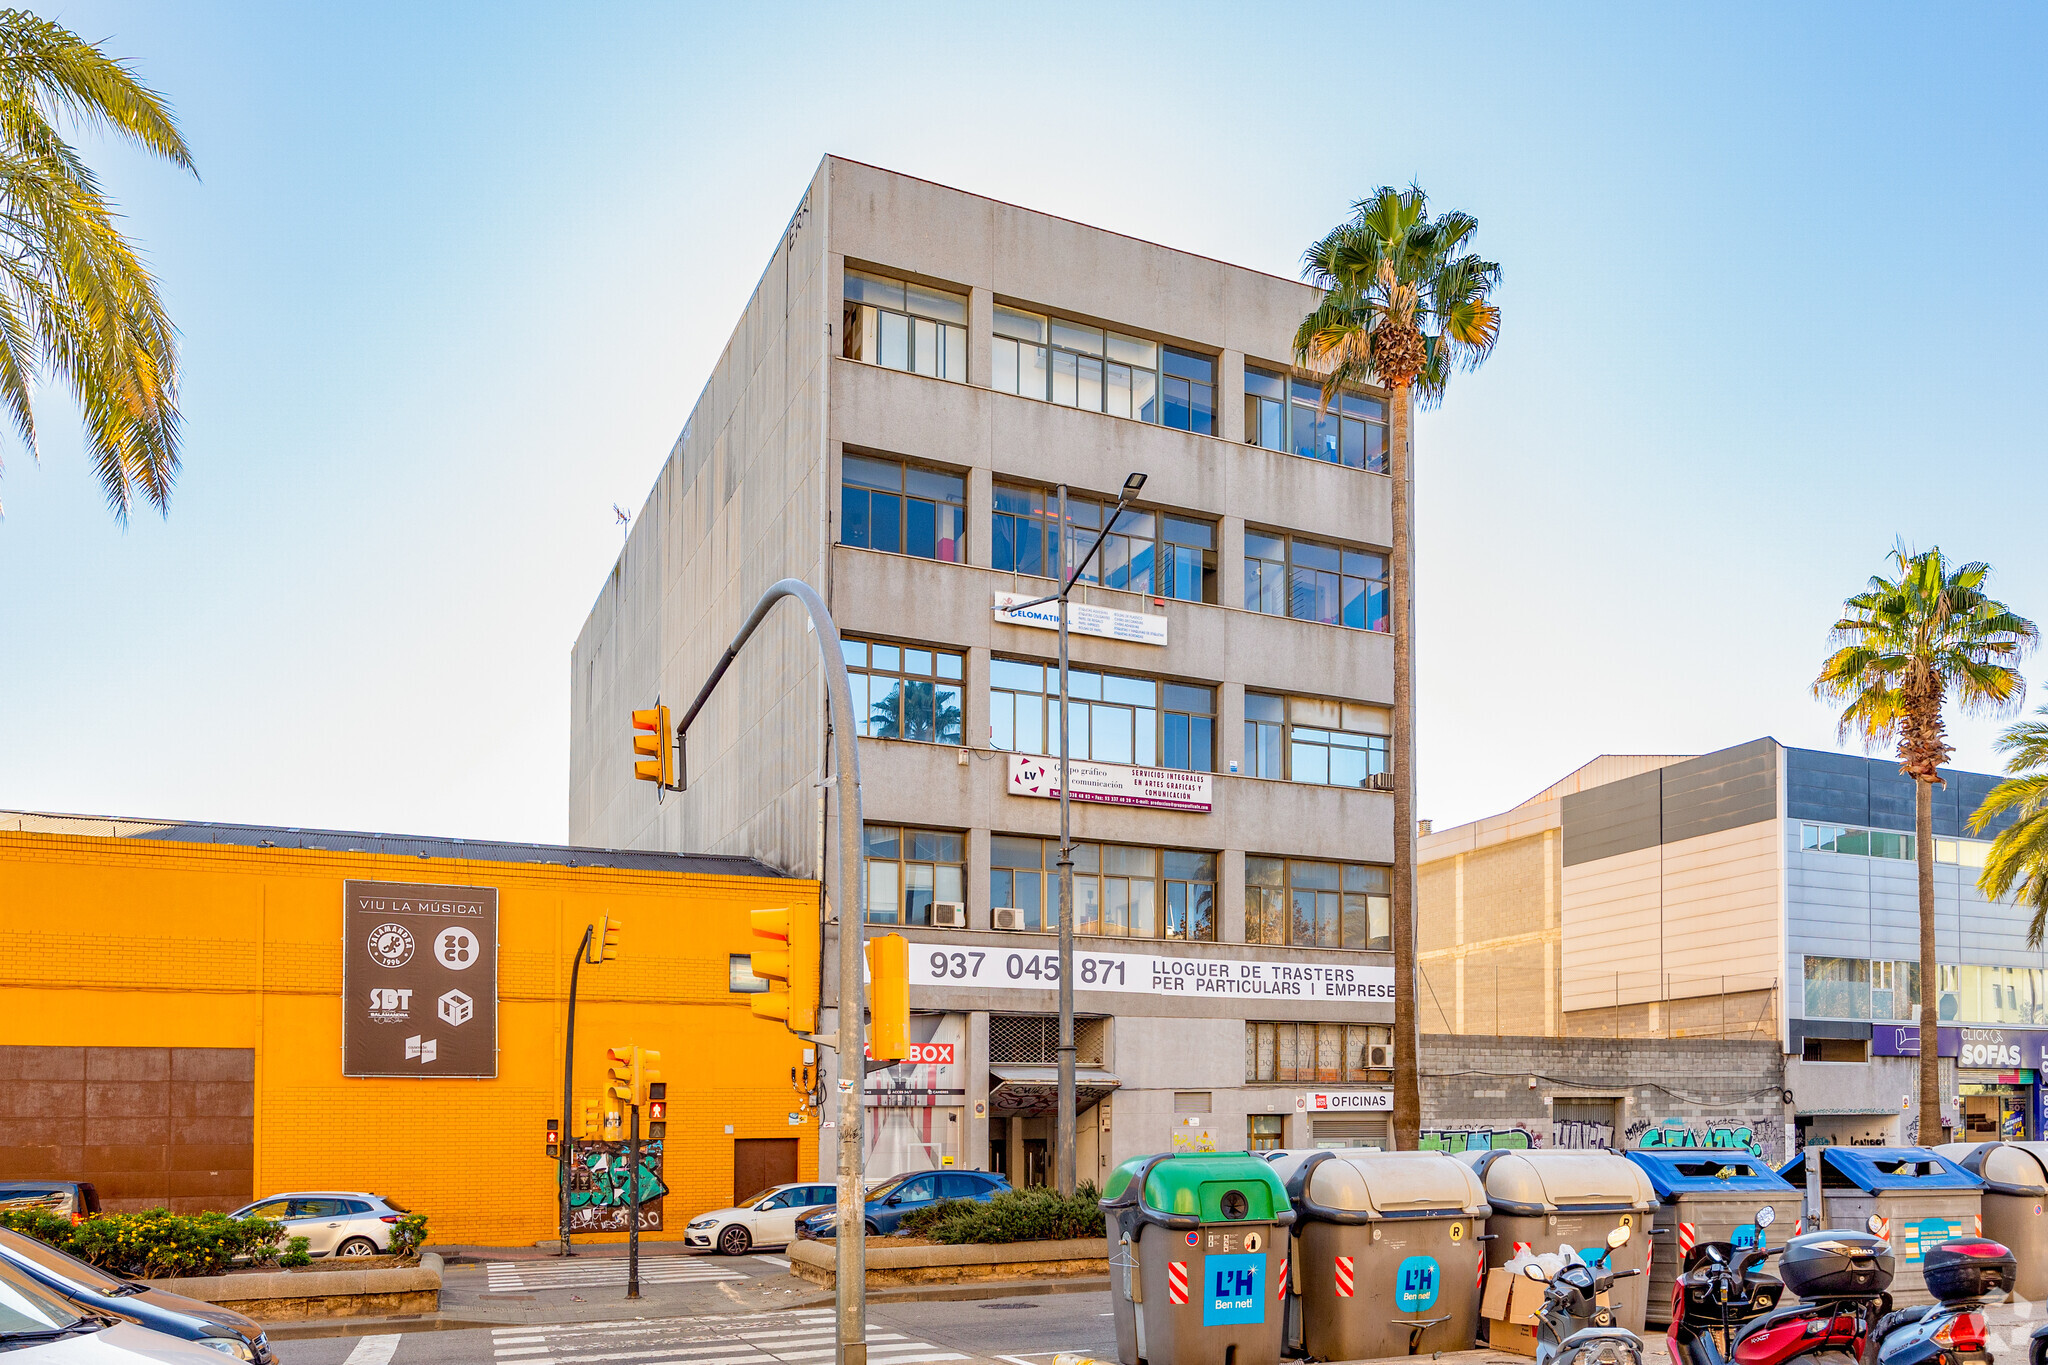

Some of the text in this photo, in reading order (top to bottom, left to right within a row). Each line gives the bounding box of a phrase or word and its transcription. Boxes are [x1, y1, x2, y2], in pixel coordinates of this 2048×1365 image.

[1025, 772, 1036, 780] LV
[1054, 763, 1107, 777] Gpo gráfico
[1132, 770, 1204, 783] SERVICIOS INTEGRALES
[1072, 778, 1123, 789] comunicación
[1166, 782, 1195, 791] GRAFICAS
[1145, 789, 1191, 799] COMUNICACIÓN
[359, 900, 482, 914] VIU LA MÚSICA!
[370, 925, 412, 949] SALAMANDRA
[383, 958, 400, 966] 1996
[930, 952, 1125, 985] 937 045 871
[1153, 960, 1354, 982] LLOGUER DE TRASTERS
[1153, 976, 1395, 997] PER PARTICULARS I EMPRESE
[369, 988, 412, 1010] SBT
[1961, 1029, 1988, 1040] CLICK
[1962, 1044, 2020, 1065] SOFAS
[1332, 1096, 1386, 1106] OFICINAS
[1453, 1227, 1460, 1236] R
[1216, 1270, 1253, 1297] L'H
[1405, 1269, 1432, 1290] L'H
[1418, 1291, 1430, 1299] net!
[1215, 1299, 1252, 1309] Ben net!
